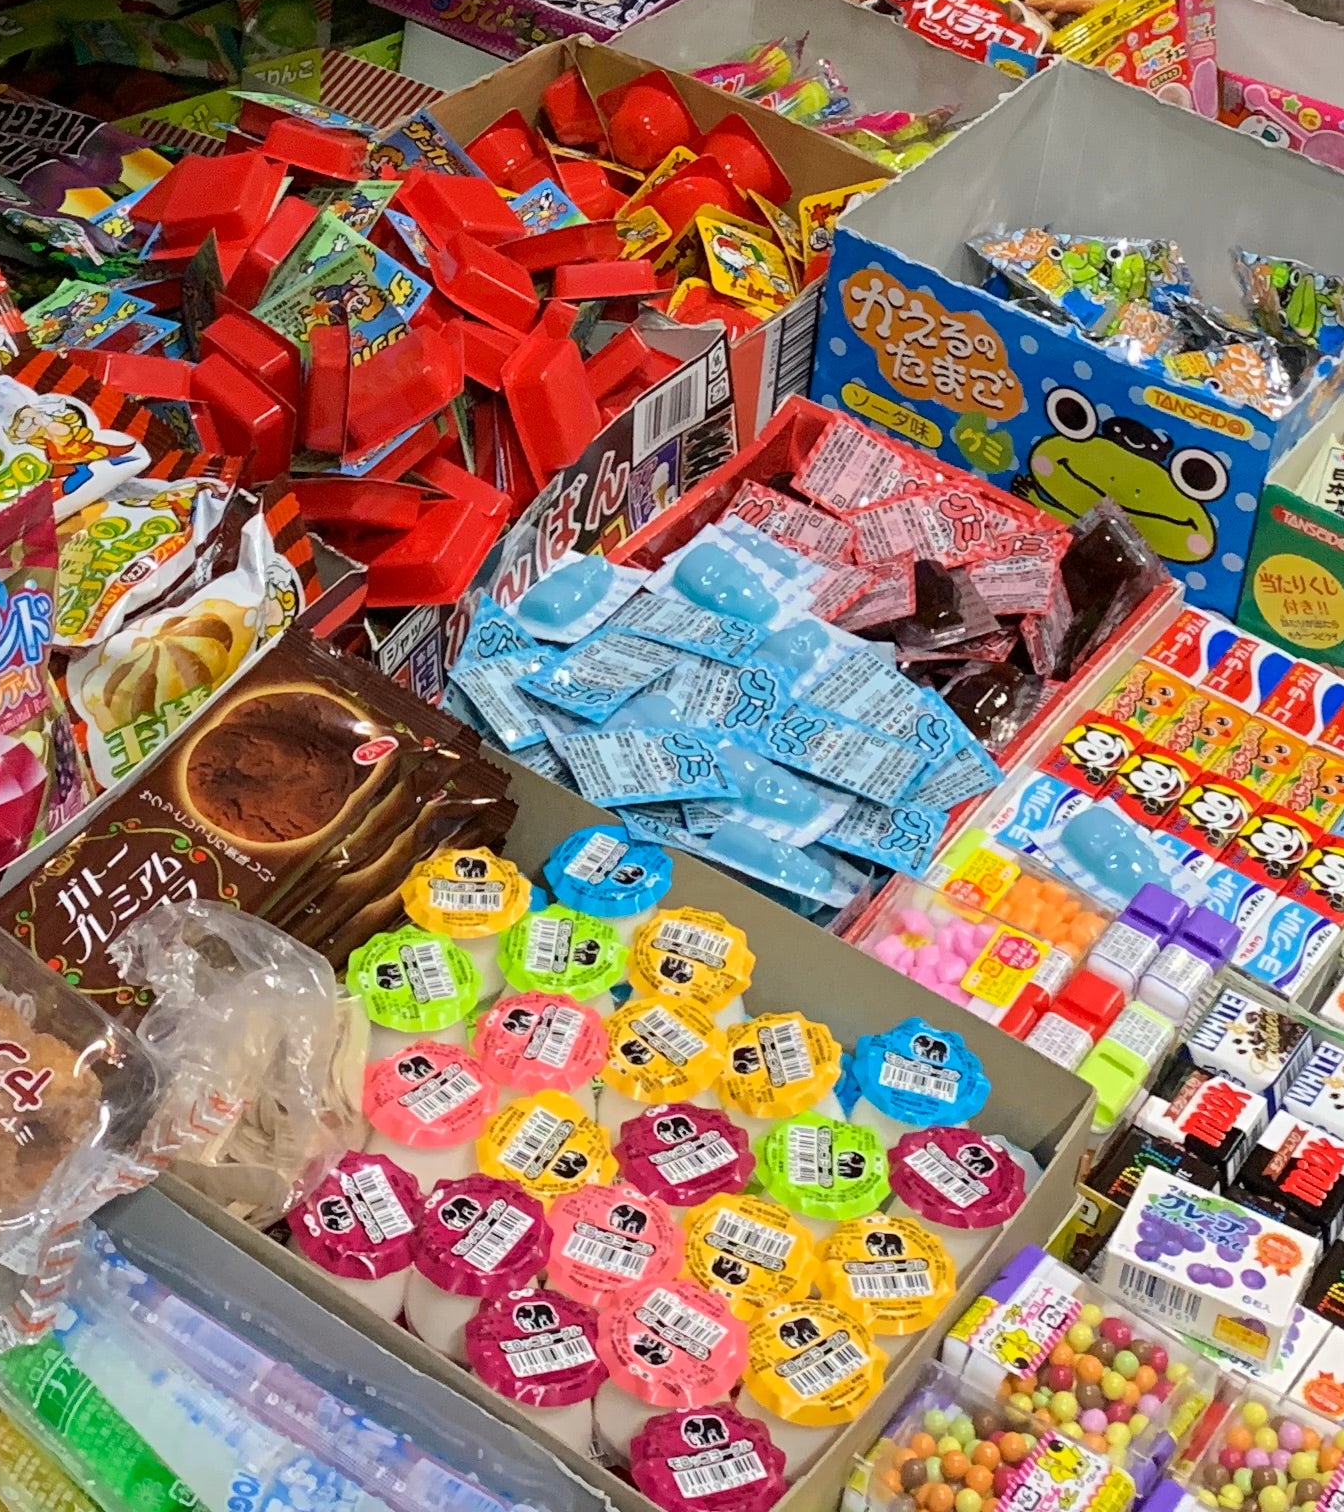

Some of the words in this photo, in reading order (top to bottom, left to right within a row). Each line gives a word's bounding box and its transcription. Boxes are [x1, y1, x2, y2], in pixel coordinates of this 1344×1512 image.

[917, 17, 976, 50] ビスケット
[850, 279, 999, 363] かえるの
[888, 341, 1017, 414] たまご
[852, 390, 932, 442] ソーダ味
[959, 421, 1007, 466] グミ
[1258, 567, 1340, 597] 当たりくじ
[1282, 598, 1330, 616] 付き!!
[1269, 667, 1322, 724] コーラガム
[54, 842, 132, 924] ガトー
[60, 851, 185, 966] プレミアム
[1259, 906, 1309, 974] ヨーグルト
[1190, 991, 1247, 1052] WHITE
[1287, 1044, 1344, 1107] WHITE
